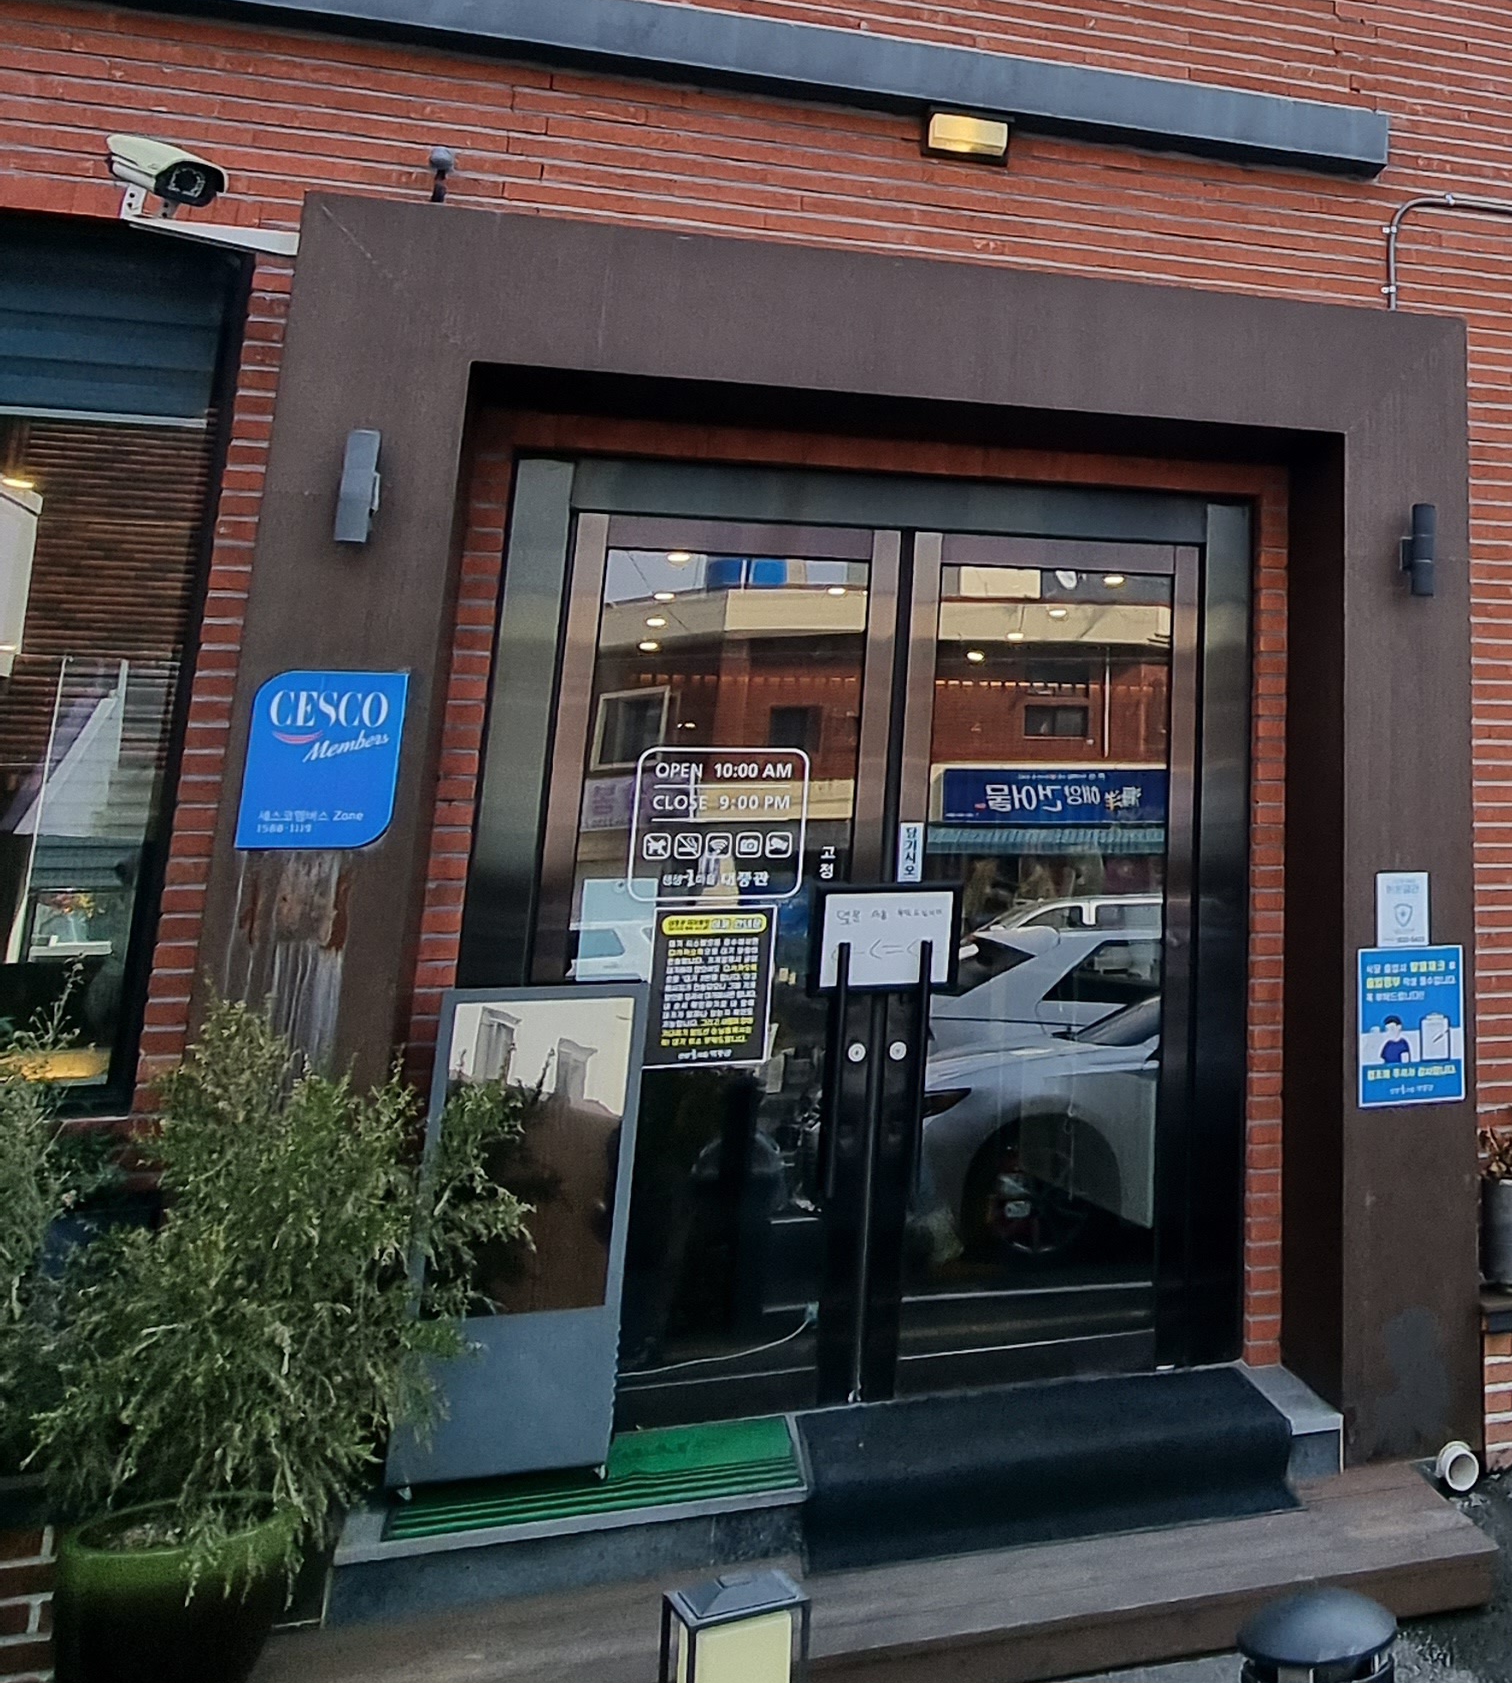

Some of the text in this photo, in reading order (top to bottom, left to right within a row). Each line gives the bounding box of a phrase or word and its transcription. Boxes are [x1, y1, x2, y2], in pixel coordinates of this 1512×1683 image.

[270, 689, 389, 728] CESCO
[302, 729, 390, 762] Members
[655, 762, 793, 779] OPEN 10:00 AM
[332, 810, 364, 821] Zone
[653, 795, 791, 811] CLOSE 9:00 PM
[819, 845, 837, 880] 고정
